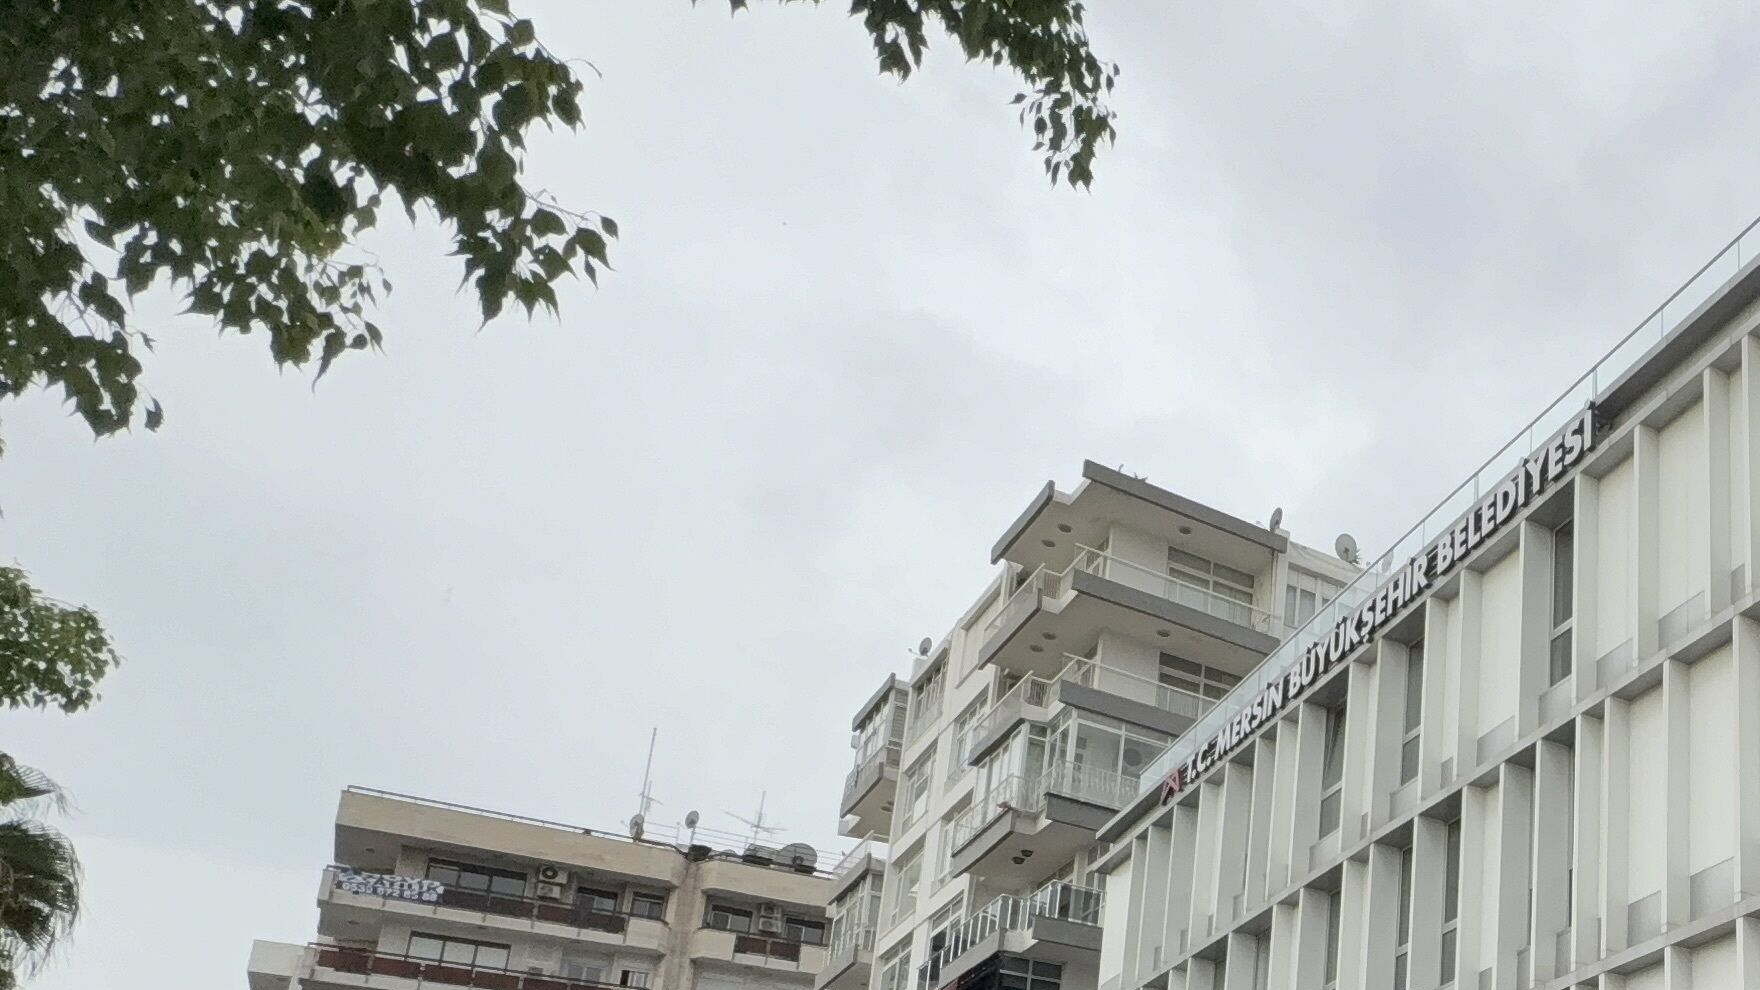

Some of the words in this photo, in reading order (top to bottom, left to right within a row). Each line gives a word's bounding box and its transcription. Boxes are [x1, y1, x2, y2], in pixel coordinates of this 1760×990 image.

[1184, 744, 1213, 784] T.C.
[1214, 680, 1286, 759] MERSİN
[1288, 555, 1430, 700] BÜYÜKŞEHİR
[1437, 399, 1595, 576] BELEDİYESİ
